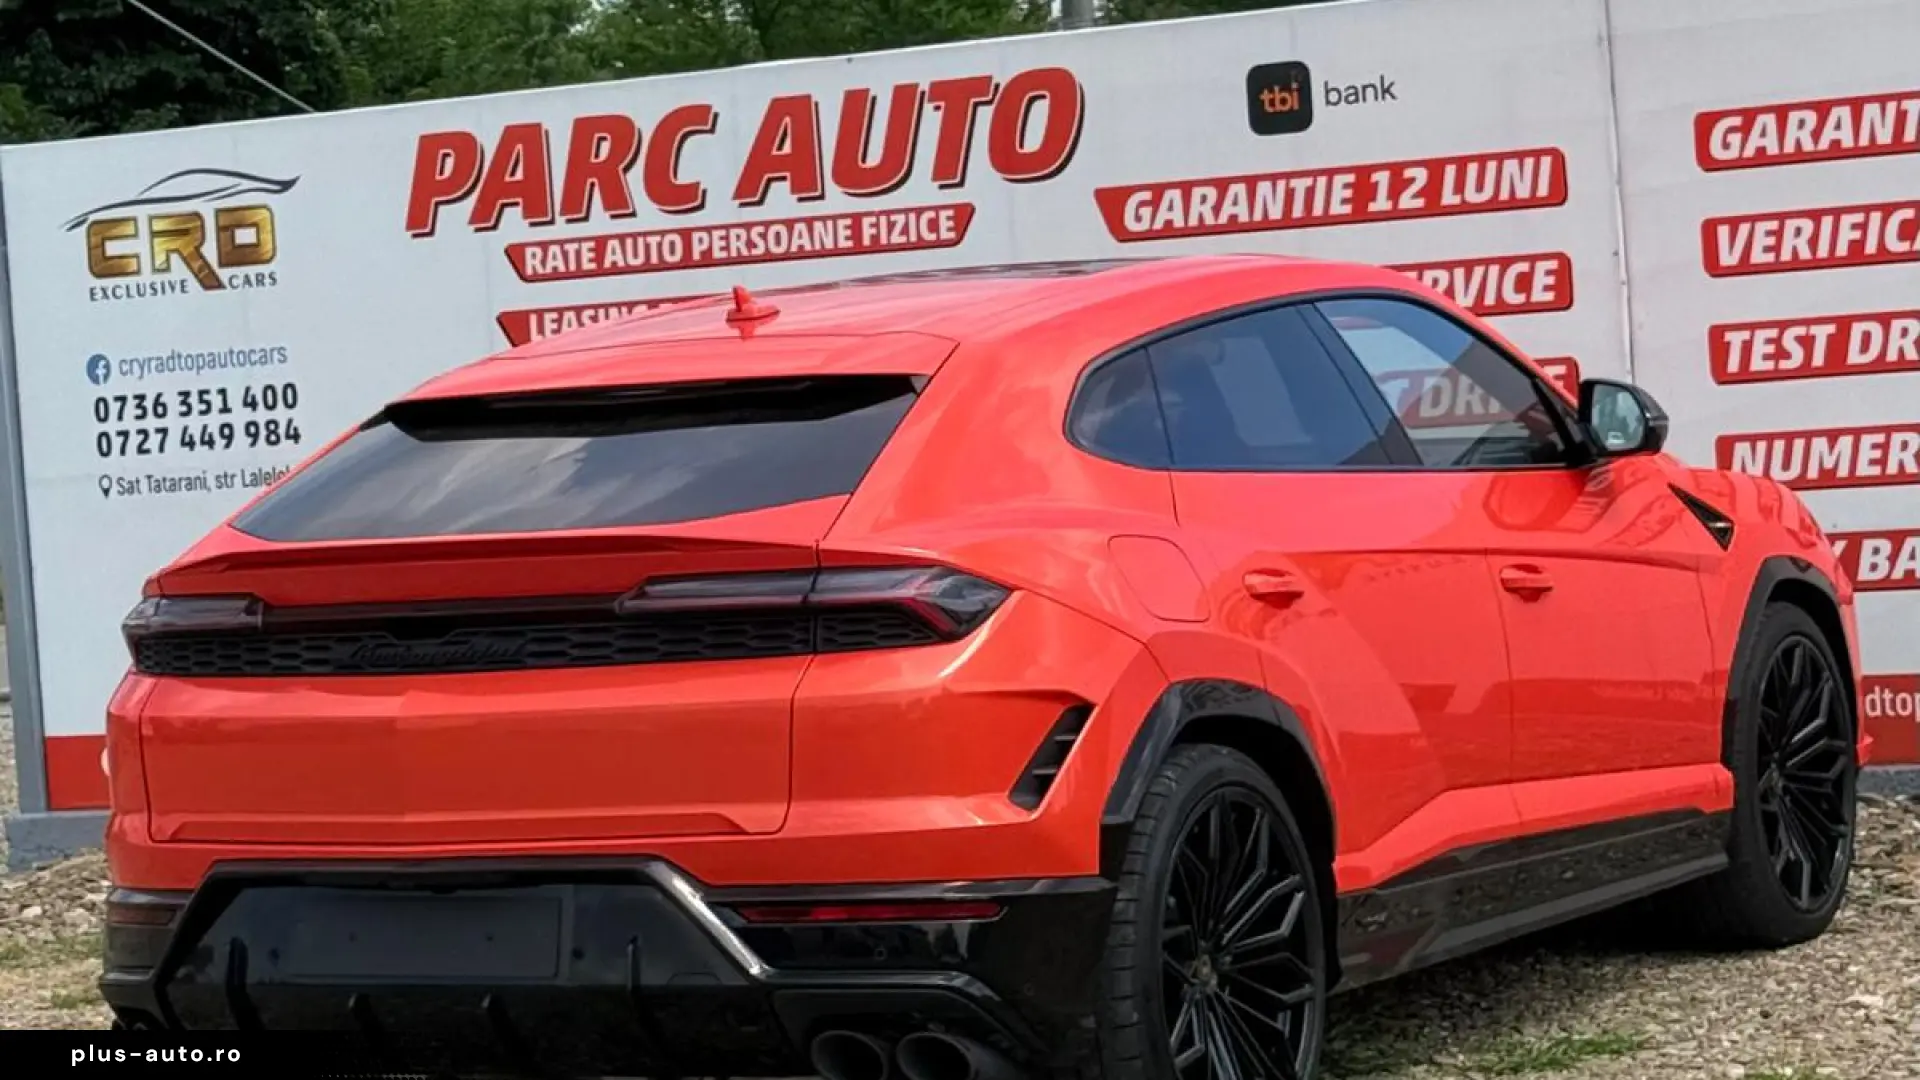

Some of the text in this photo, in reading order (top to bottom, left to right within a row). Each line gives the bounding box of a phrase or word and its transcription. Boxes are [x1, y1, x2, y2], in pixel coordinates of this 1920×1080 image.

[1259, 74, 1399, 113] tbi bank
[405, 67, 1084, 236] PARC AUTO
[1709, 99, 1920, 161] GARANT
[1123, 155, 1553, 233] GARANTIE 12 LUNI
[87, 204, 277, 291] CRD
[524, 209, 957, 276] RATE AUTO PERSOANE FIZICE
[1716, 208, 1920, 267] VERIFIC
[89, 271, 278, 302] EXCLUSIVE CARS
[1398, 259, 1560, 308] RVICE
[118, 346, 288, 380] cryradtopautocars
[1723, 317, 1920, 374] TEST DR
[94, 382, 298, 424] 0736 351 400
[97, 418, 302, 458] 0727 449 984
[1731, 431, 1920, 481] NUMER
[116, 476, 142, 496] Sat
[144, 470, 212, 493] Tatarani,
[215, 475, 237, 489] str
